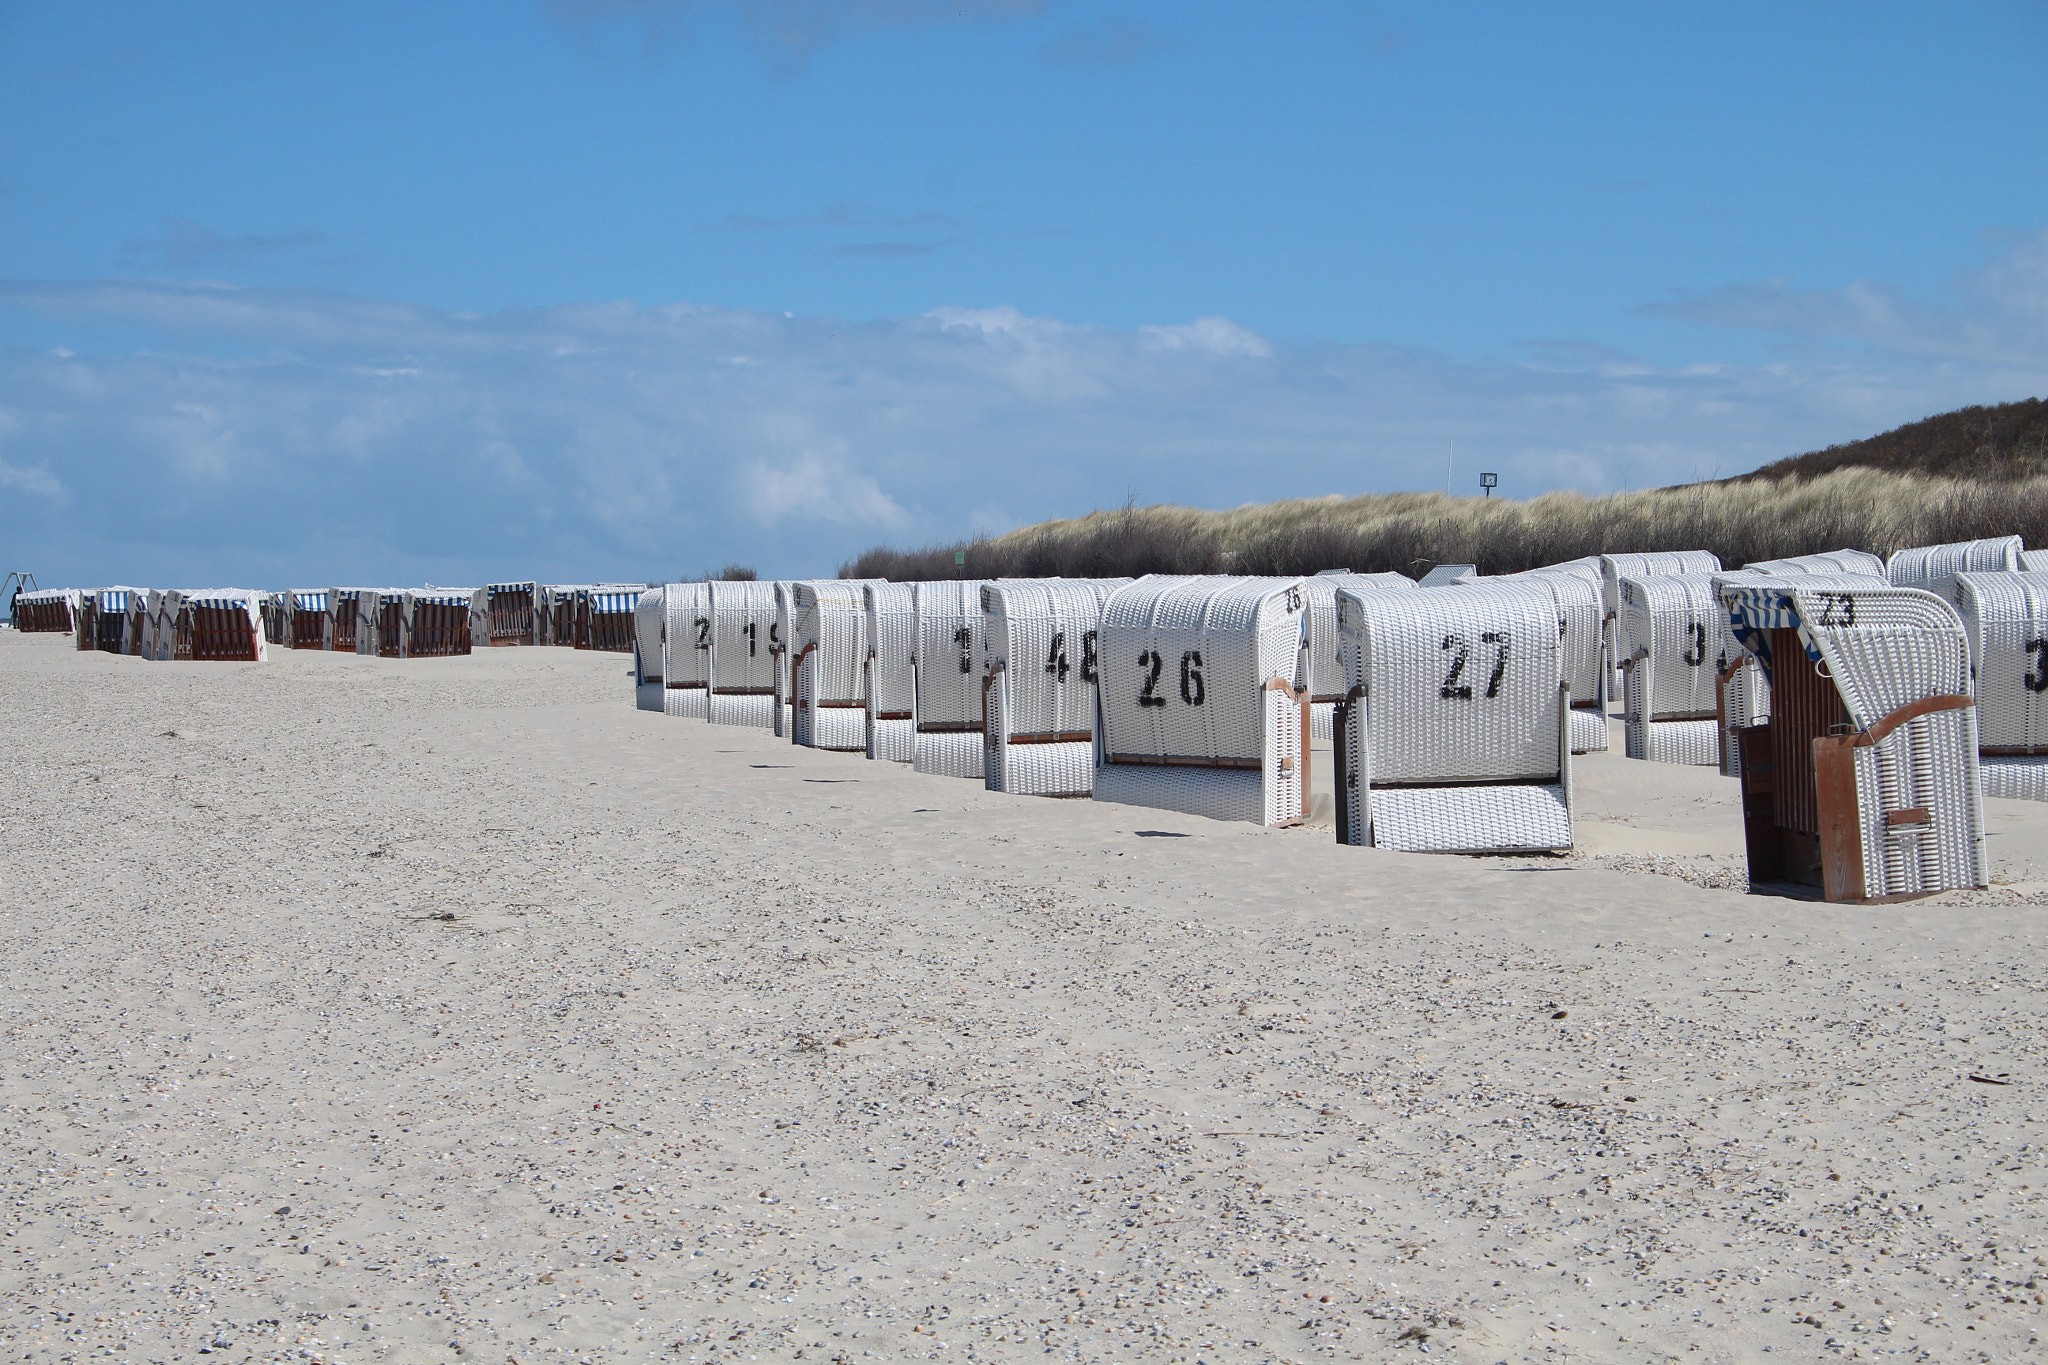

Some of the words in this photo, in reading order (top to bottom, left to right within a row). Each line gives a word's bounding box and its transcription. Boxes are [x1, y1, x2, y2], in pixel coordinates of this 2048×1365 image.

[1817, 592, 1855, 628] 23
[1138, 649, 1206, 708] 26
[1440, 631, 1511, 700] 27
